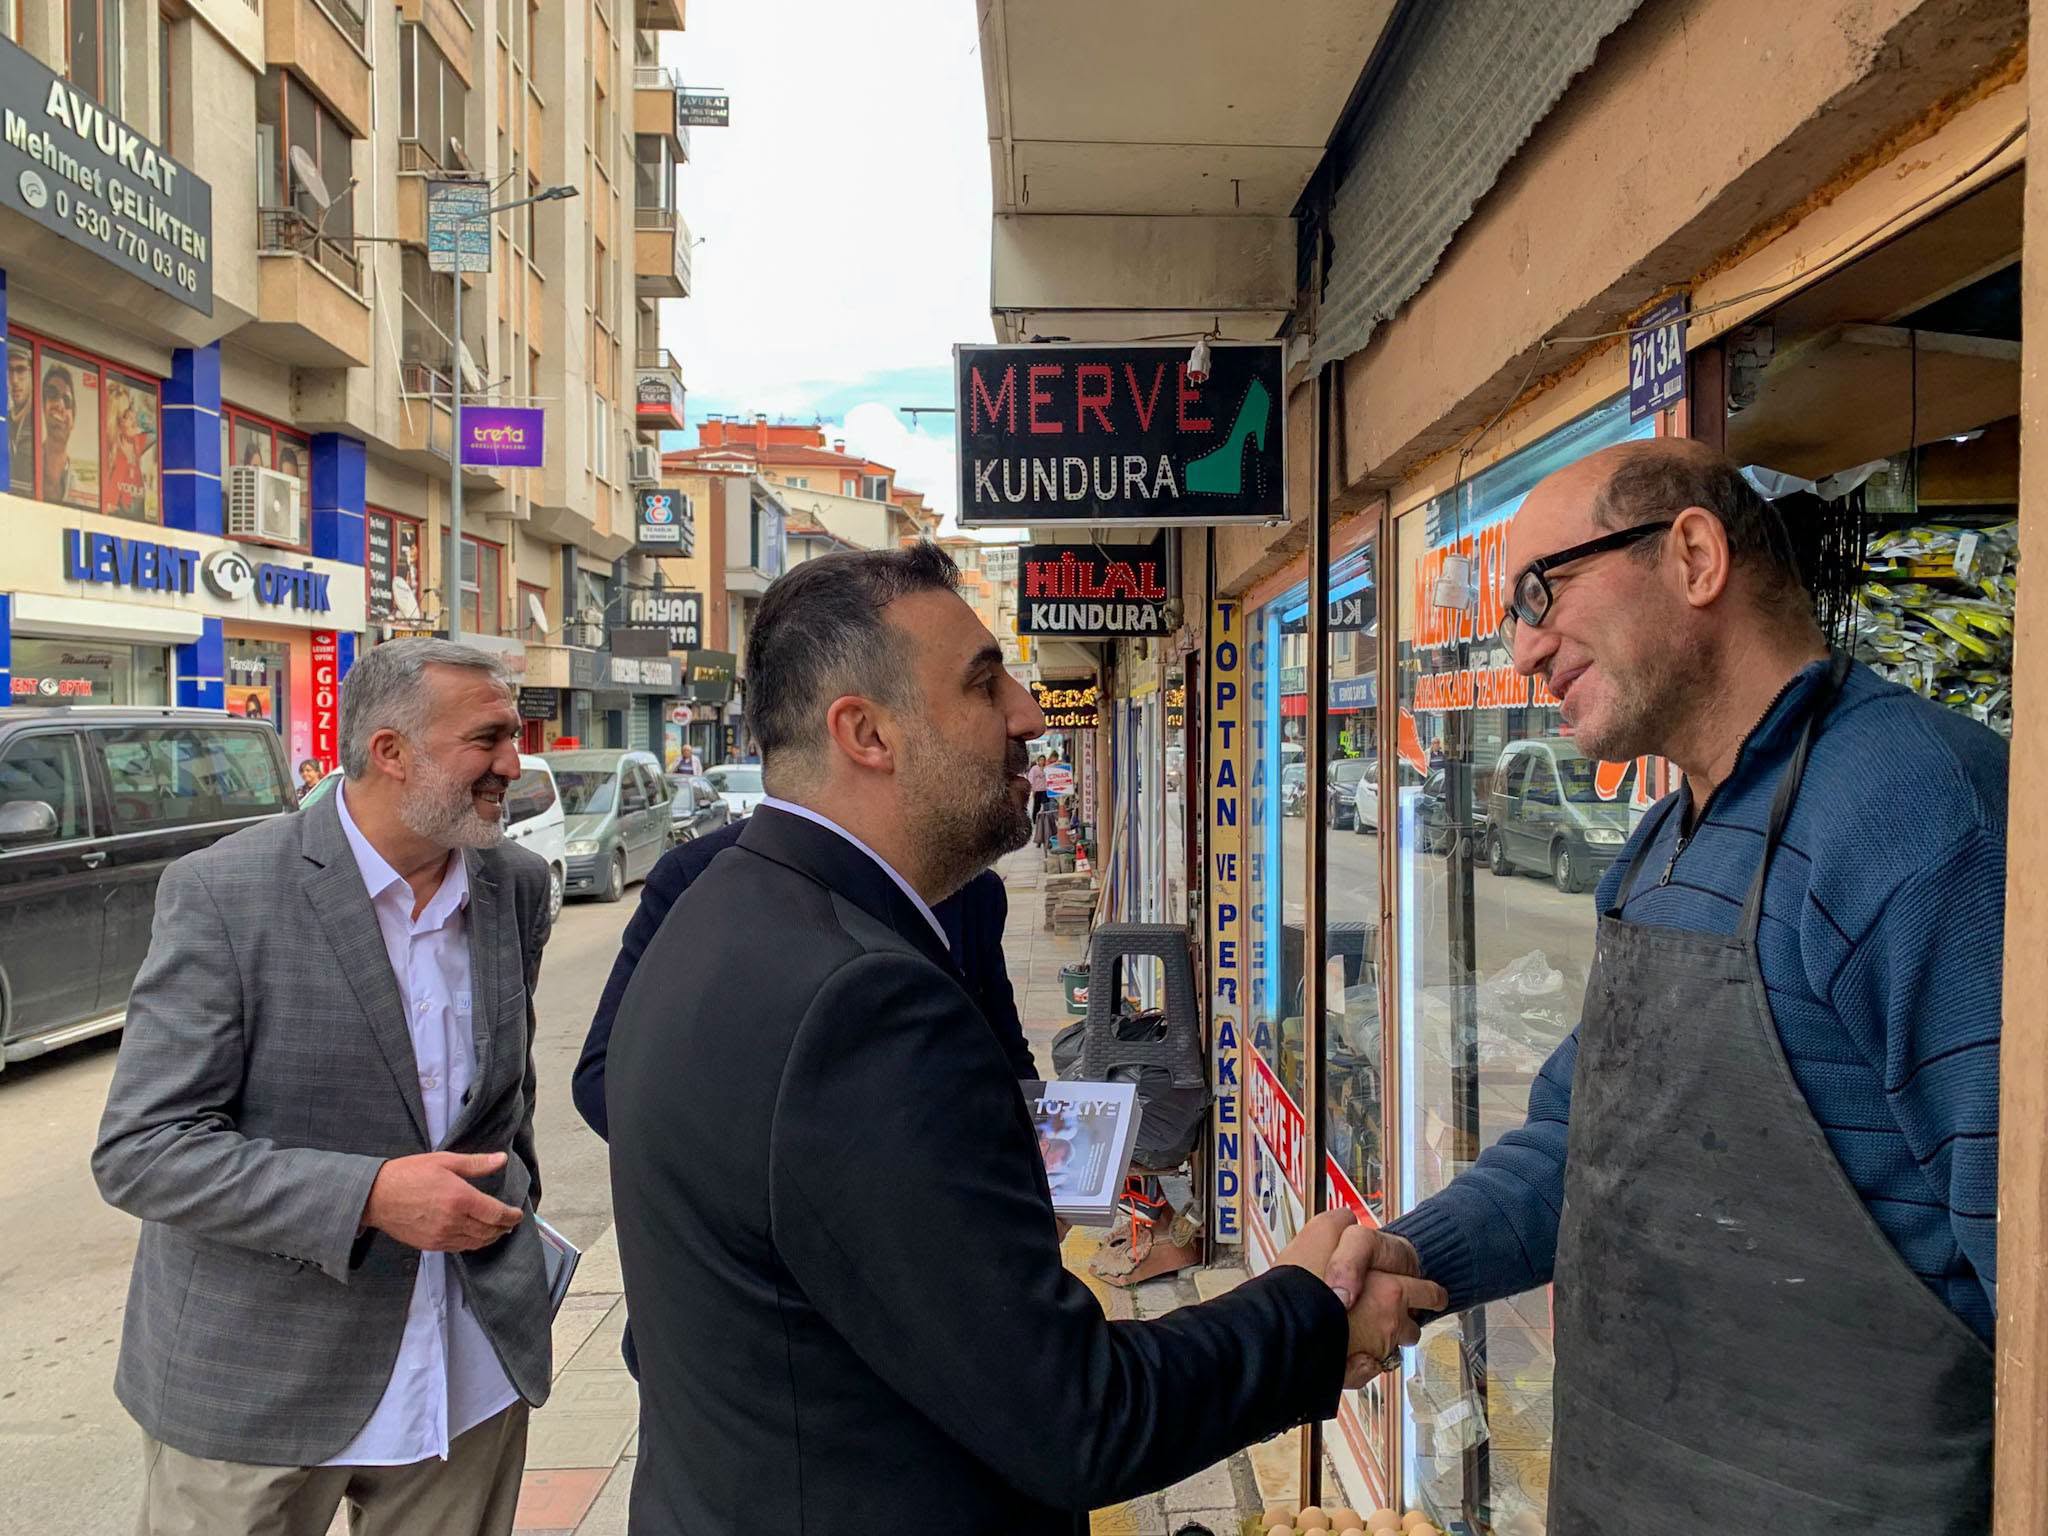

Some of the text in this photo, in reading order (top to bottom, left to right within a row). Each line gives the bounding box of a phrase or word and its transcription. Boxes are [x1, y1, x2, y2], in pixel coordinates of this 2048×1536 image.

[46, 80, 177, 197] AVUKAT
[4, 108, 207, 264] Mehmet ÇELİKTEN
[56, 190, 197, 293] 0 530 770 03 06
[971, 363, 1214, 435] MERVE
[974, 454, 1180, 502] KUNDURA
[69, 529, 331, 612] LEVENT OPTİK
[1025, 551, 1166, 598] HİLAL
[631, 599, 698, 622] NAYAN
[1031, 603, 1158, 631] KUNDURA
[316, 667, 334, 777] GÖZLÜ
[1044, 711, 1100, 727] undura
[1414, 669, 1475, 712] AYAKKABI
[1216, 603, 1241, 1236] TOPTAN VE PERAKENDE
